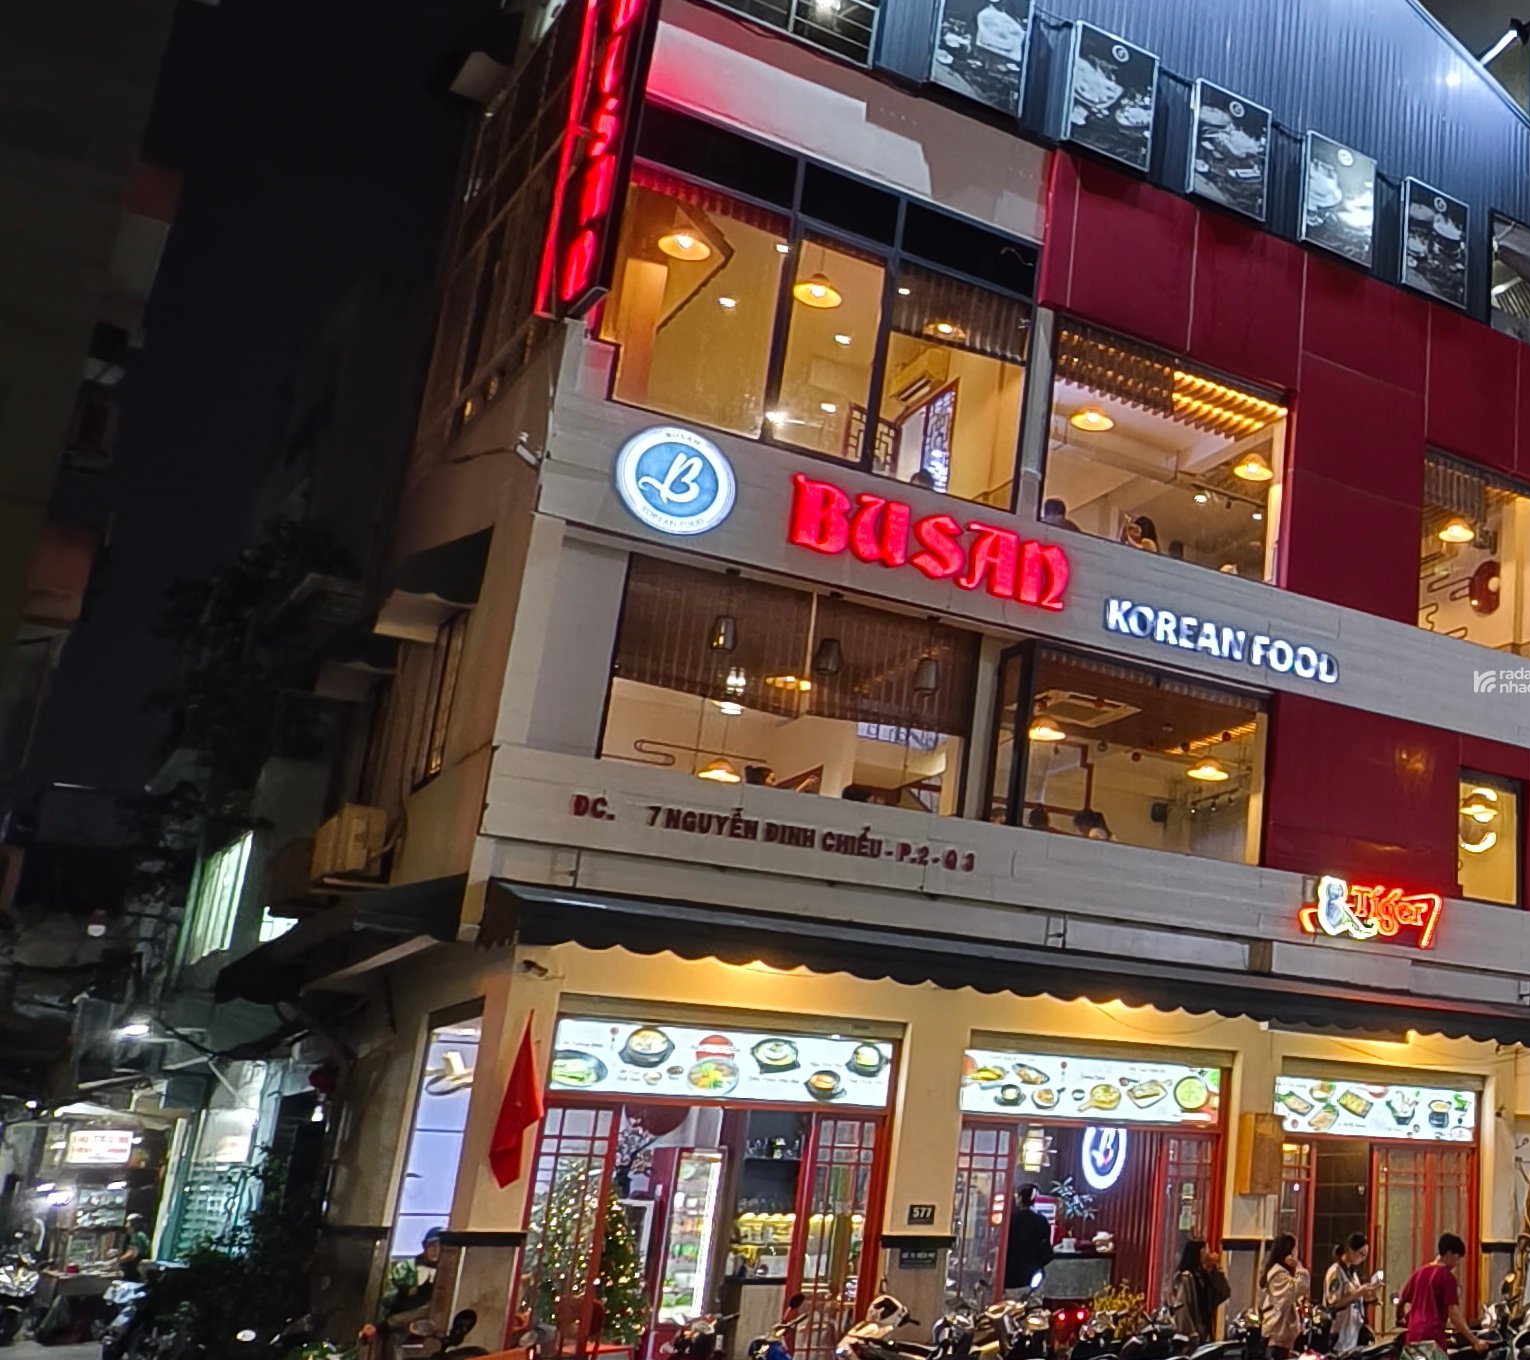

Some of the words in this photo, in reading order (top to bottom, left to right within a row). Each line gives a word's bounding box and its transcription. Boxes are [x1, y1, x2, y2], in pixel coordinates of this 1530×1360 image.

[790, 474, 1070, 611] BUSAN
[1105, 598, 1246, 660] KOREAN
[1251, 635, 1340, 685] FOOD
[646, 805, 662, 828] 7
[1350, 884, 1429, 937] Tiger
[912, 1206, 932, 1218] 577
